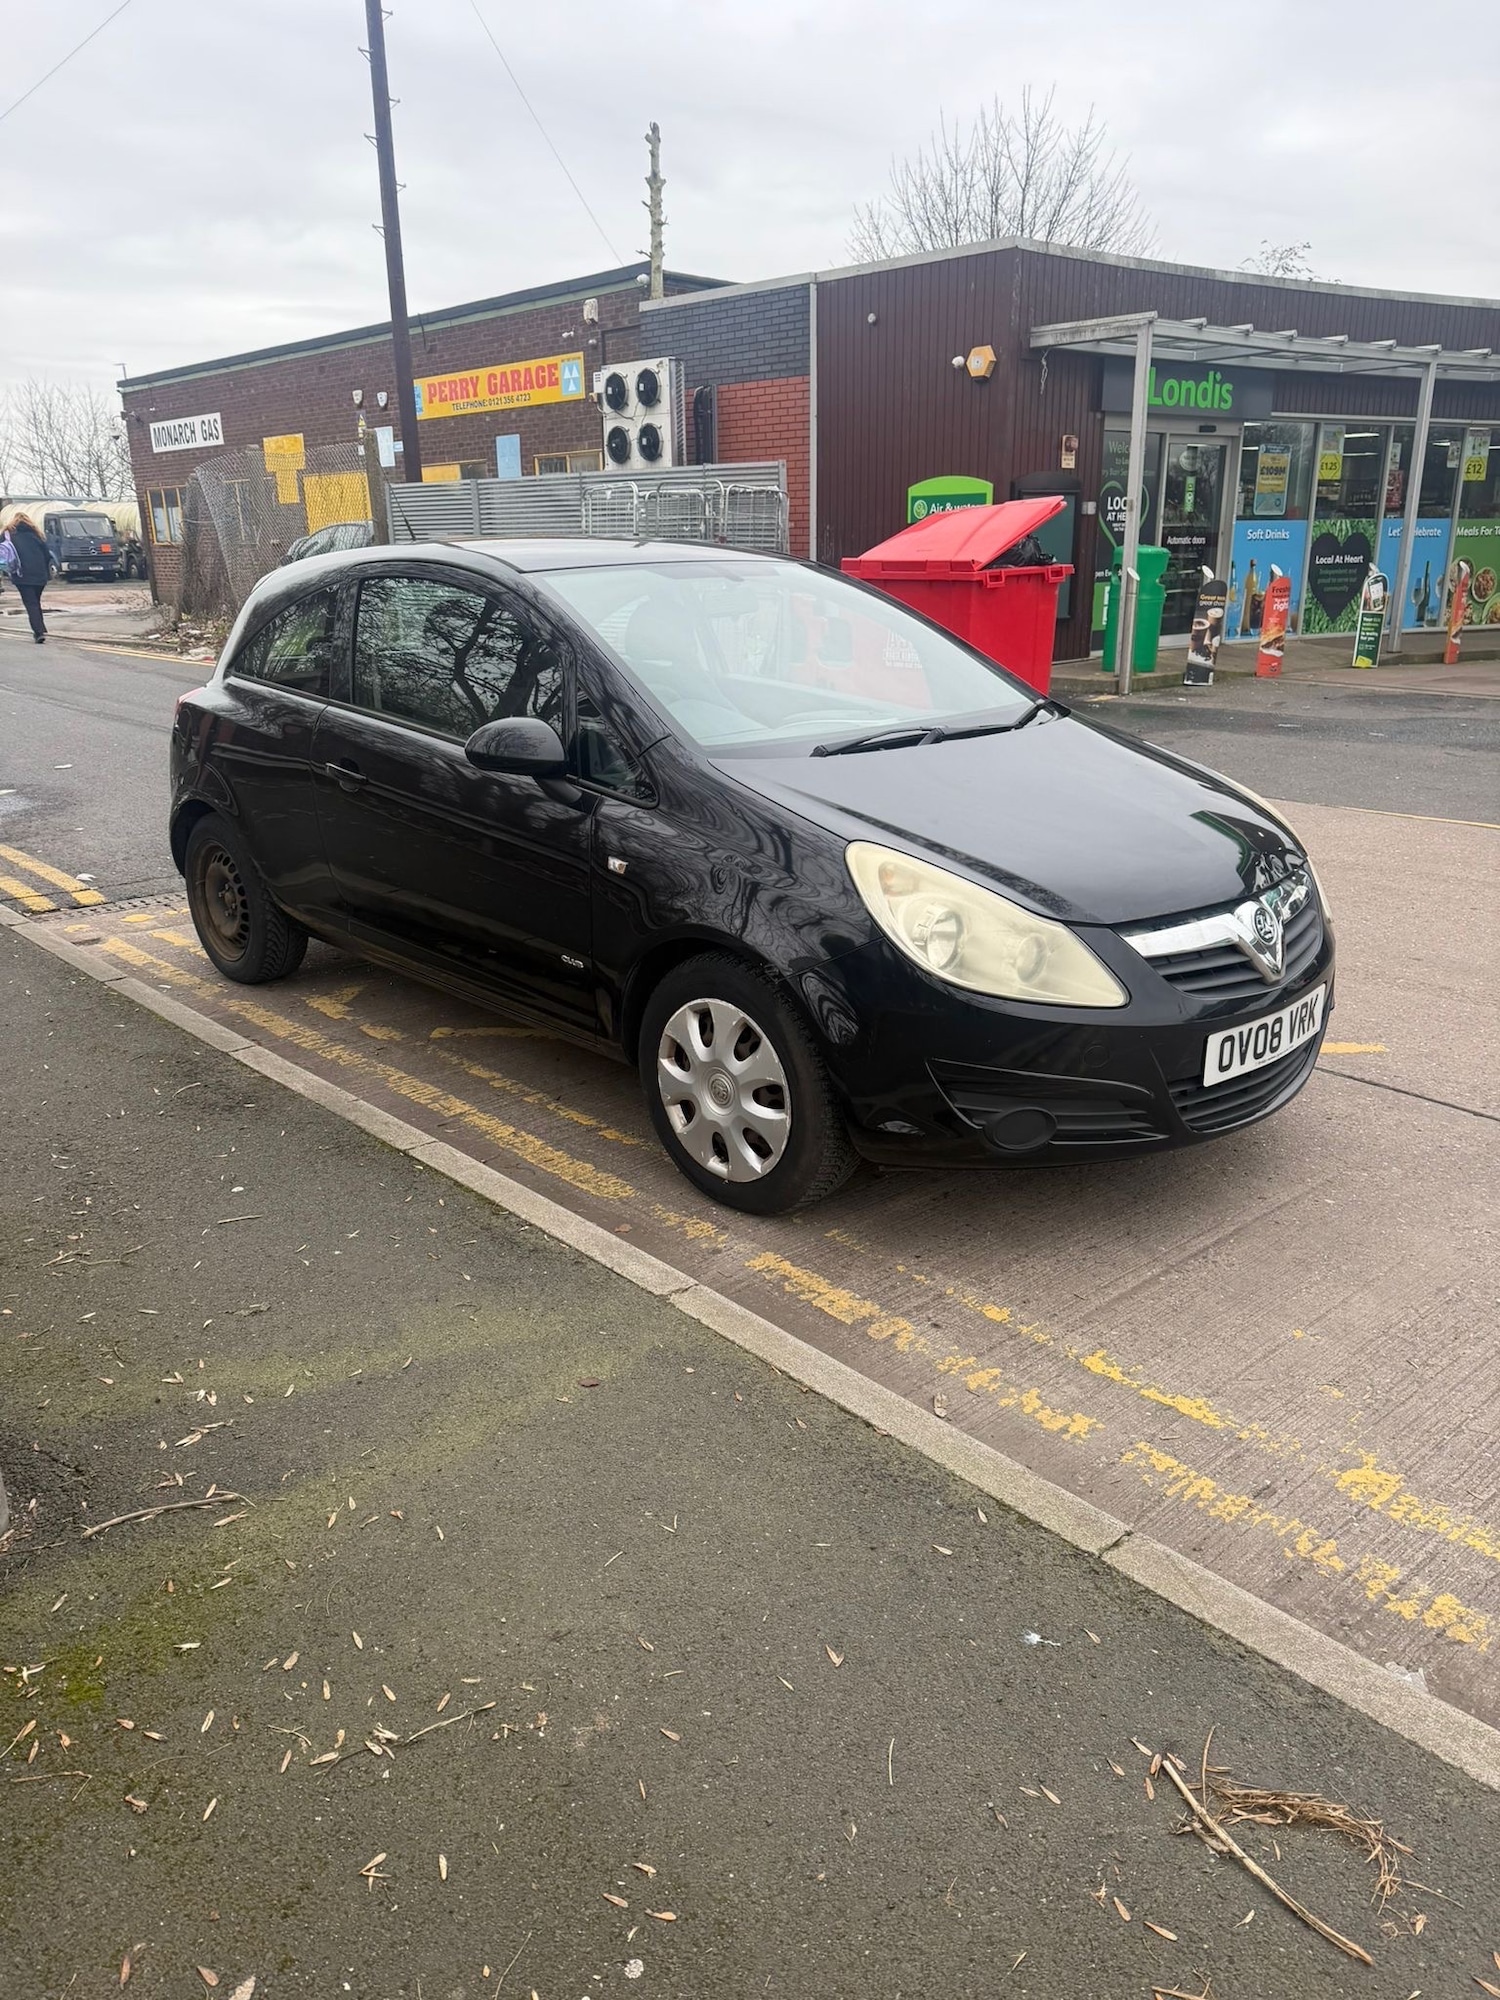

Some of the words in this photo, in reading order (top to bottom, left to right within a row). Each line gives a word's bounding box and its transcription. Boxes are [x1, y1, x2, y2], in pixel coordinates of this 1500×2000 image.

[427, 375, 480, 404] PERRY
[487, 363, 559, 395] GARAGE
[1147, 366, 1233, 410] Londis
[516, 393, 531, 402] 4723
[153, 422, 197, 448] MONARCH
[201, 418, 220, 442] GAS
[1465, 463, 1482, 474] £12
[929, 503, 944, 514] Air
[1107, 496, 1127, 510] LOC
[1106, 512, 1116, 521] AT
[1247, 529, 1263, 540] Soft
[1264, 529, 1289, 540] Drinks
[1388, 526, 1403, 537] Let'
[1414, 526, 1441, 537] lebrate
[1456, 526, 1479, 537] Meals
[1480, 526, 1493, 536] For
[1167, 535, 1191, 545] Automatic
[1192, 536, 1206, 545] doors
[1315, 554, 1334, 565] Local
[1334, 554, 1343, 564] At
[1344, 554, 1364, 564] Heart
[1218, 1016, 1283, 1073] OV08
[1289, 993, 1319, 1044] VRK
